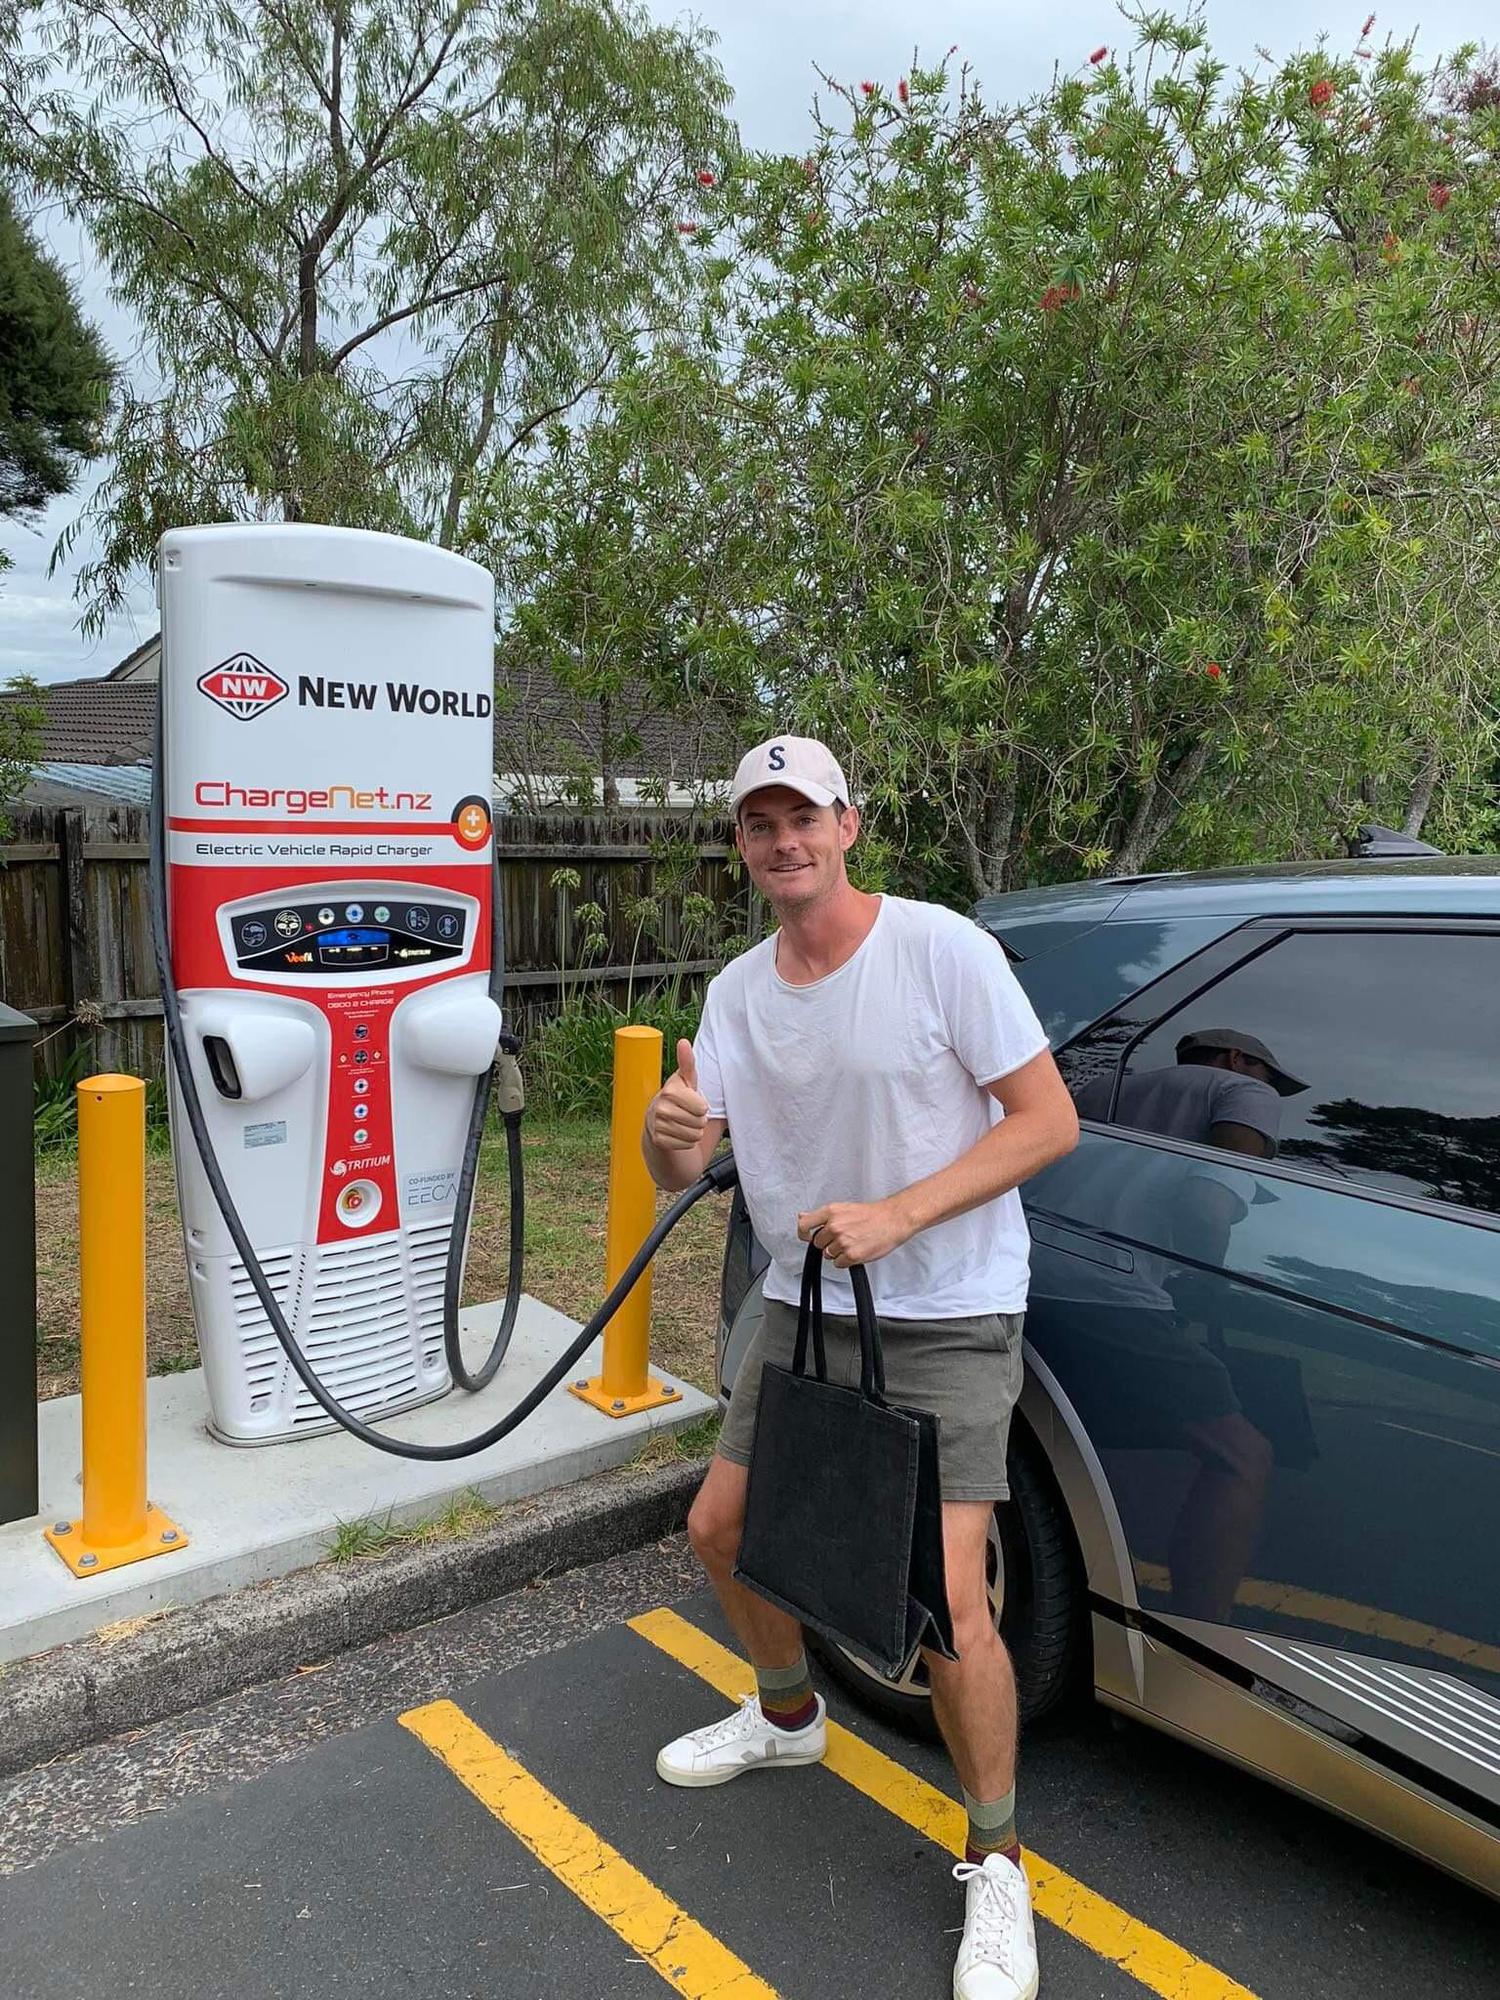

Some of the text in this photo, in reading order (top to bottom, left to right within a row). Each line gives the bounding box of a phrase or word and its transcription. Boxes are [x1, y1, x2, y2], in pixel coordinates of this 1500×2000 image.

[221, 677, 268, 698] NW
[298, 675, 491, 718] NEW WORLD
[768, 746, 785, 771] S
[195, 782, 432, 814] ChargeNet.nz
[196, 843, 433, 858] Electric Vehicle Rapid Charger
[327, 990, 370, 1000] Emergency
[346, 1155, 391, 1171] TRITIUM
[408, 1173, 446, 1185] CO-FUNDED
[408, 1183, 459, 1206] EECA
